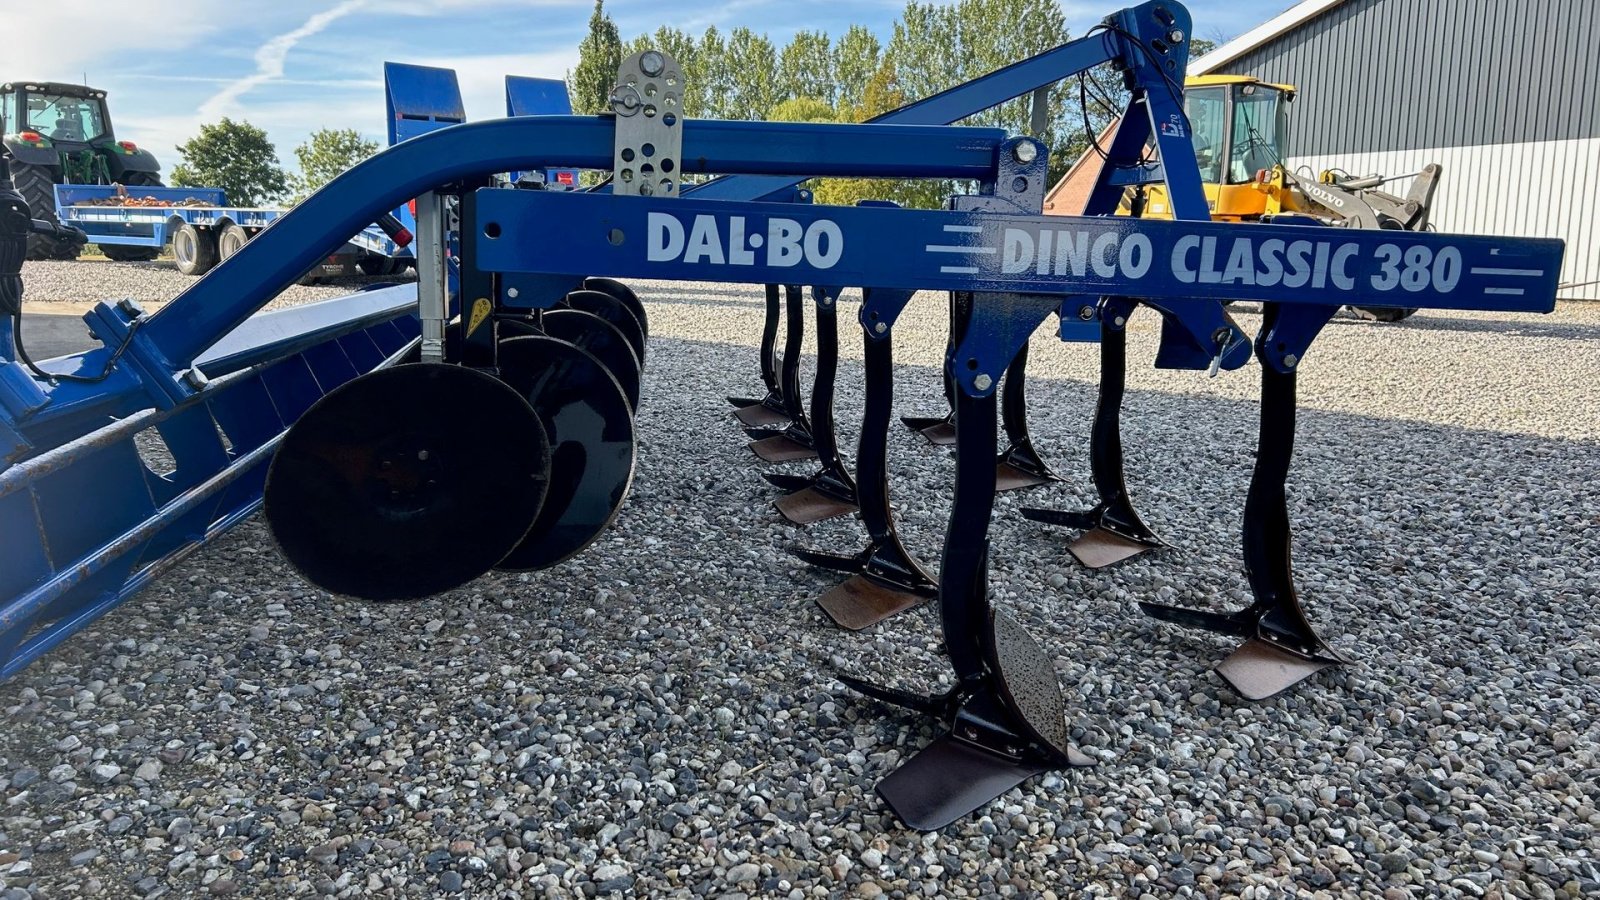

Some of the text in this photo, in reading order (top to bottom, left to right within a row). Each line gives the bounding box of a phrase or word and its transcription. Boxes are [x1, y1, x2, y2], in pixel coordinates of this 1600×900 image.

[1304, 182, 1344, 208] VOLVO
[1001, 228, 1463, 294] DINCO CLASSIC 380
